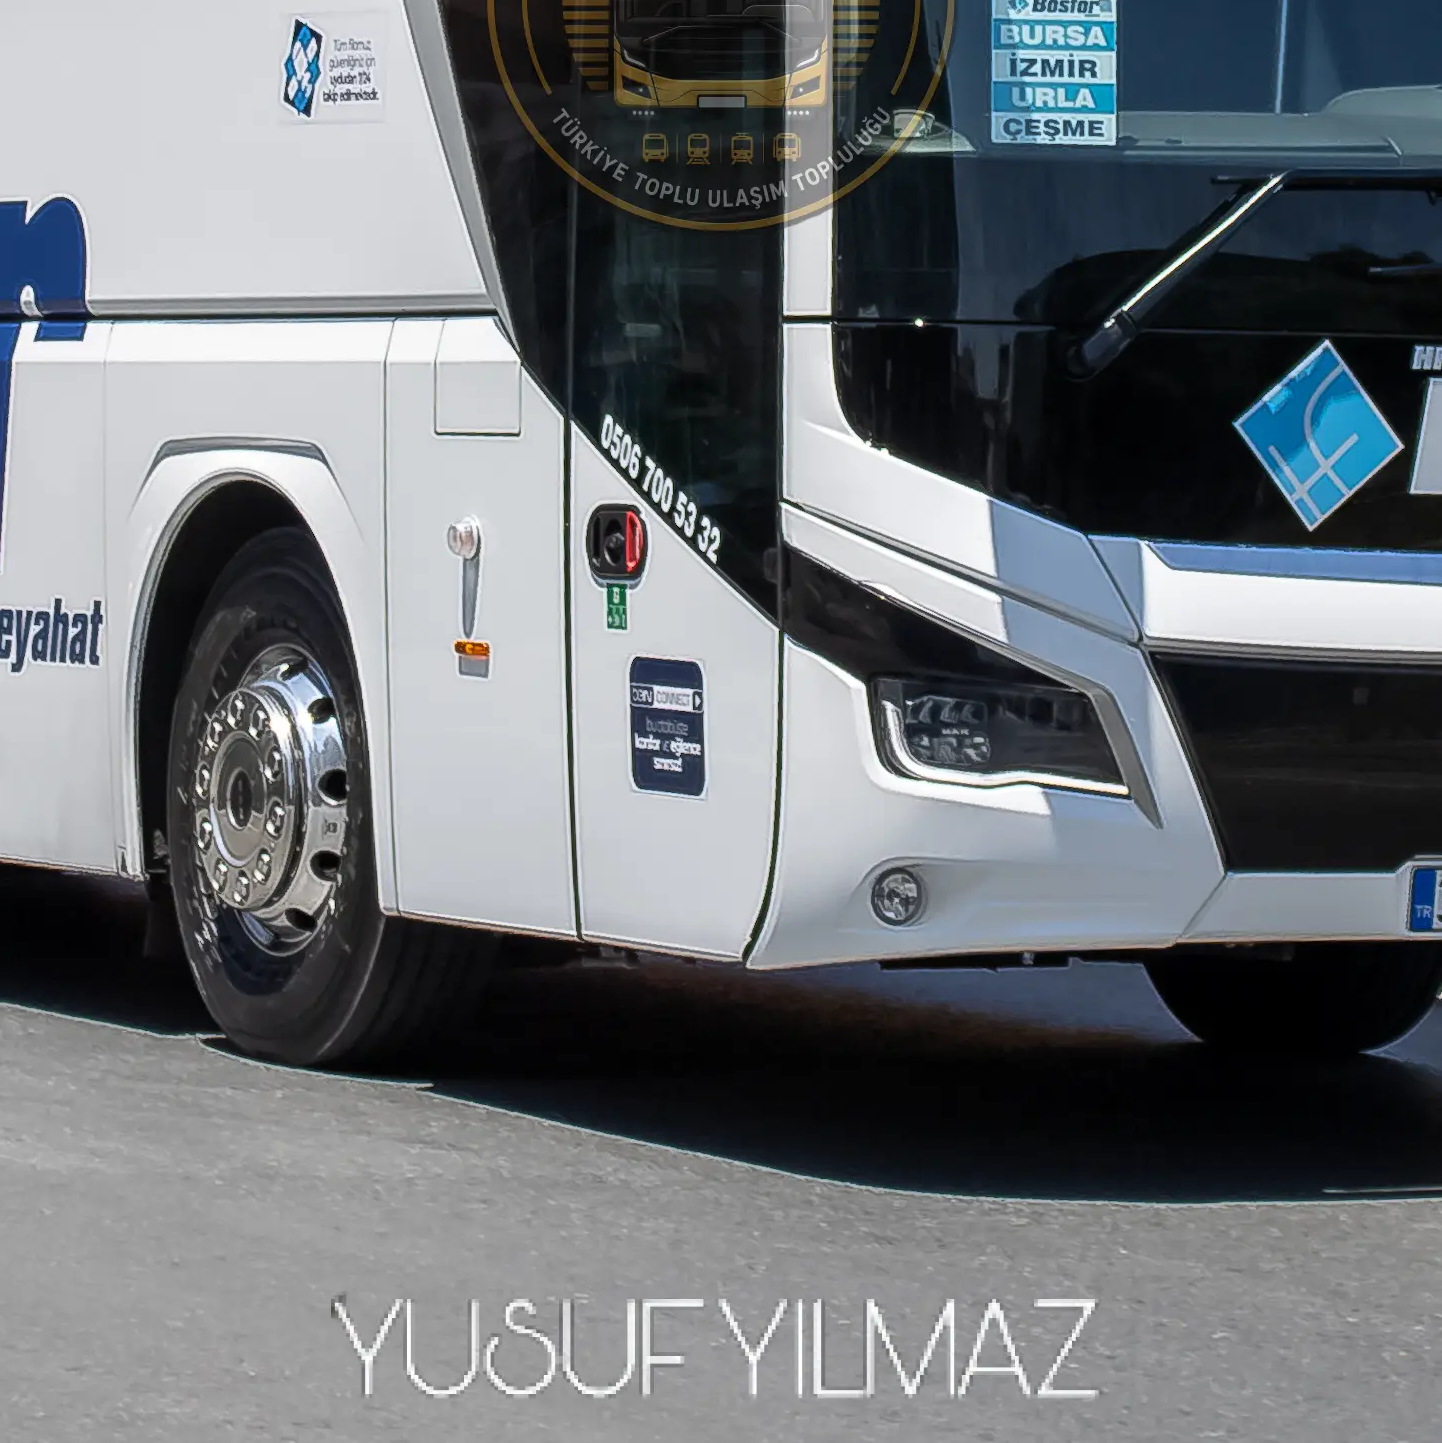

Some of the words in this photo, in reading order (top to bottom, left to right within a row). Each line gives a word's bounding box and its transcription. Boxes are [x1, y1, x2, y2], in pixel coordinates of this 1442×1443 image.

[1000, 24, 1107, 46] BURSA
[1009, 53, 1098, 78] İZMİR
[1011, 86, 1096, 108] URLA
[1002, 117, 1105, 142] ÇEŞME
[601, 414, 642, 479] 0506
[642, 456, 674, 513] 700
[673, 491, 697, 538] 53
[697, 515, 721, 565] 32
[1415, 904, 1432, 919] TR
